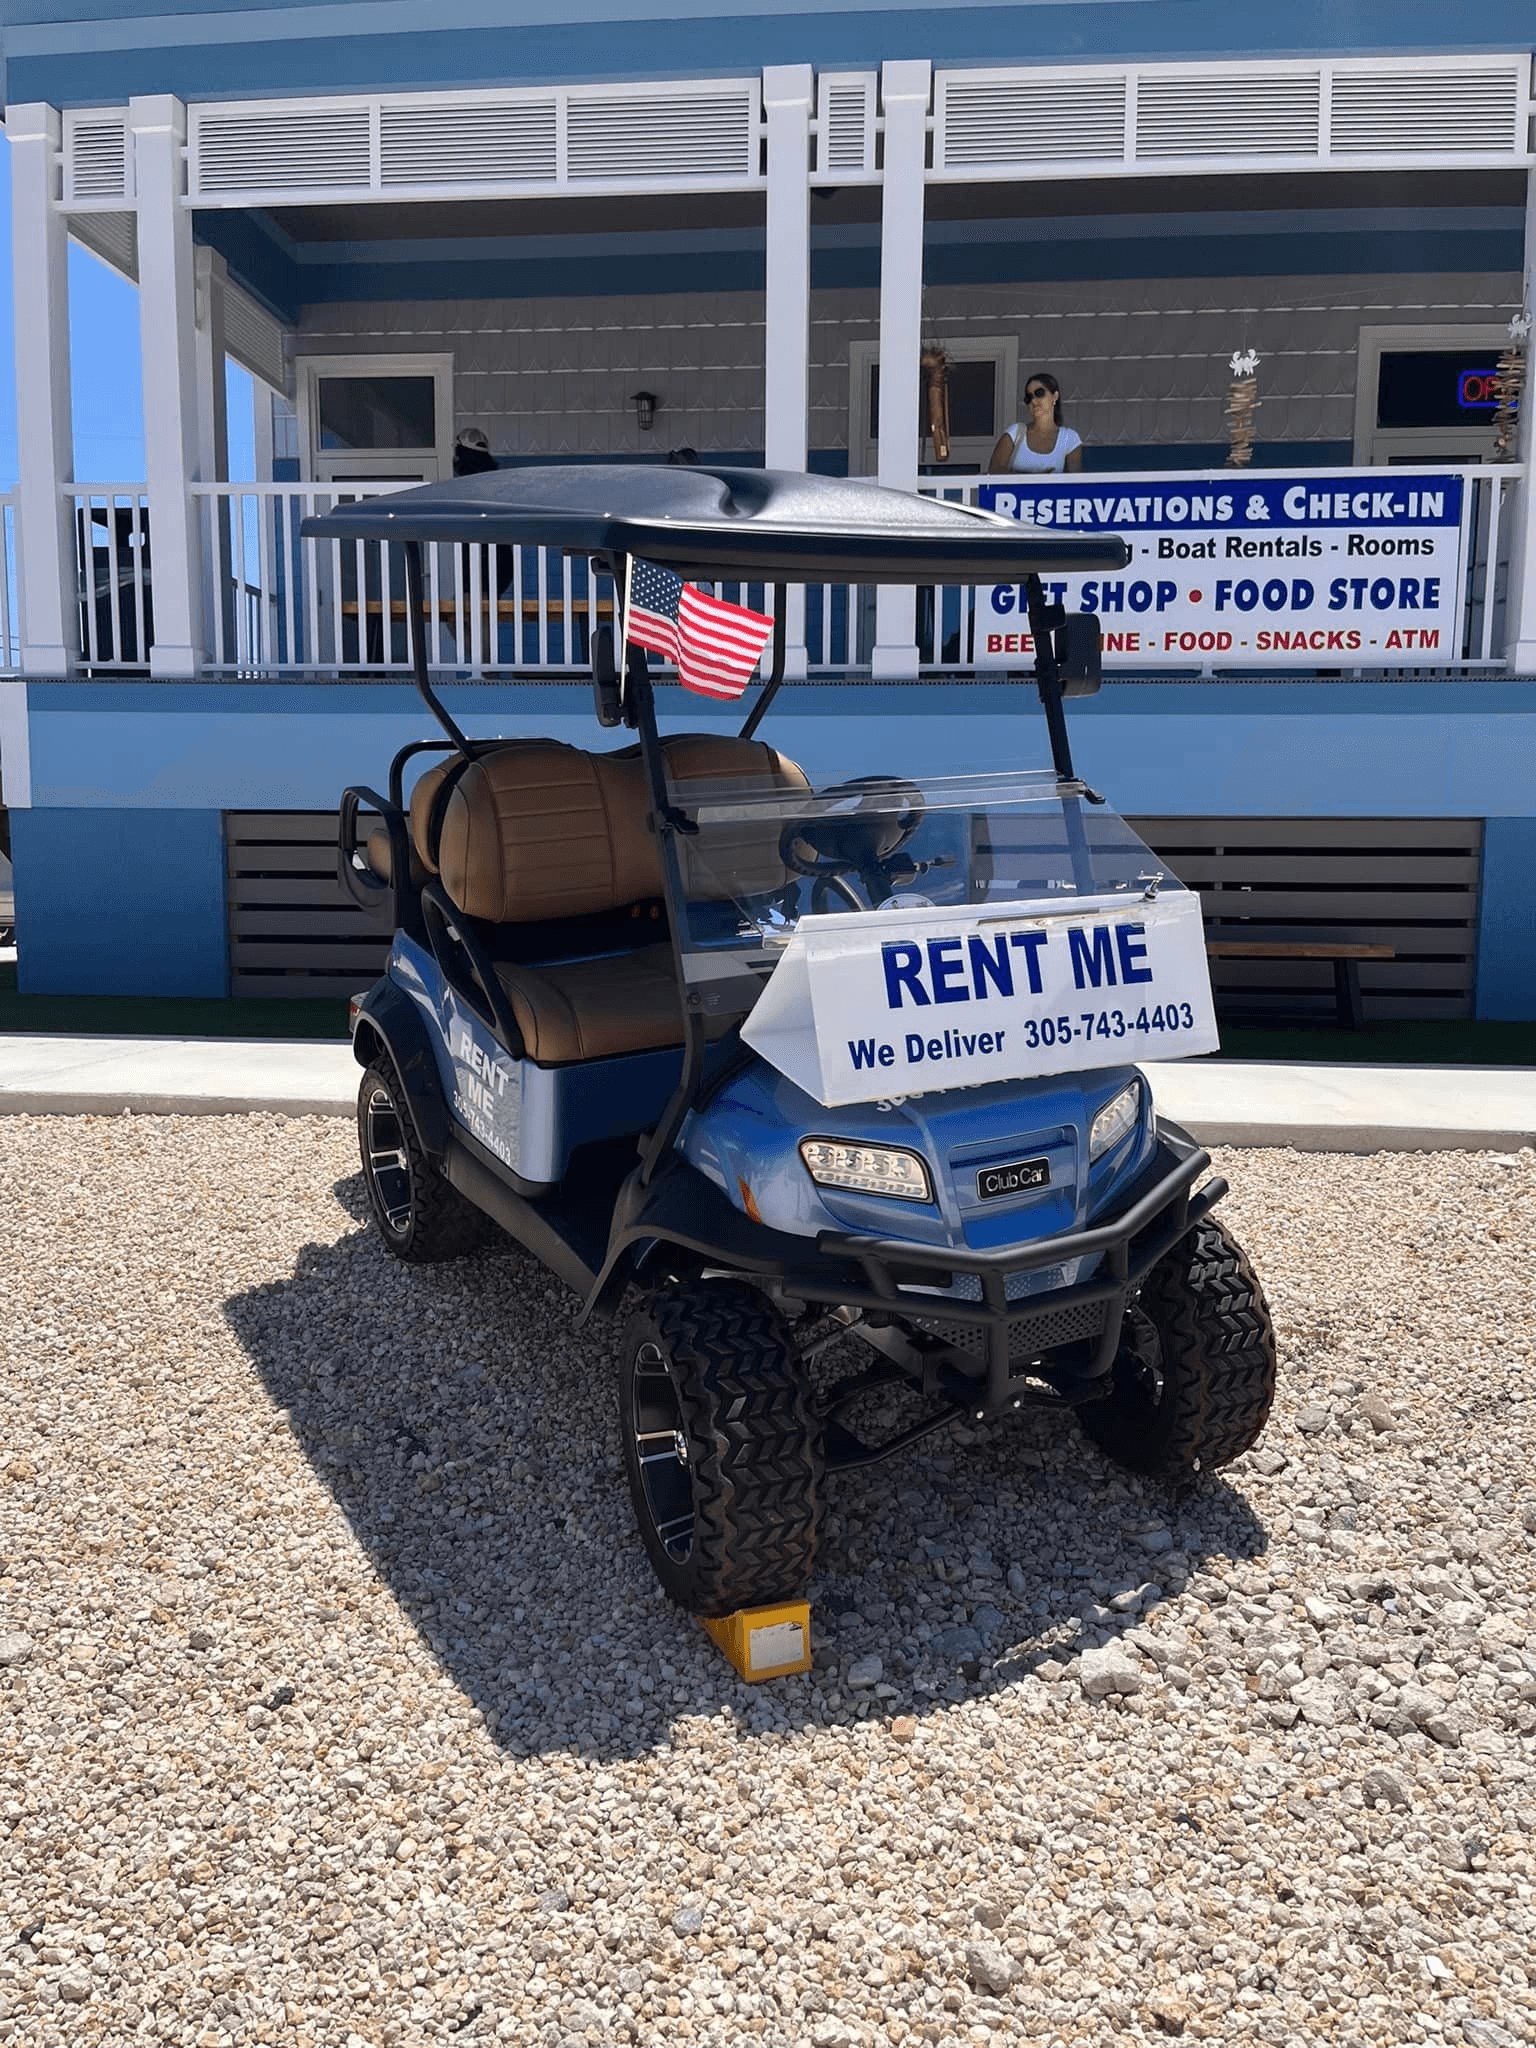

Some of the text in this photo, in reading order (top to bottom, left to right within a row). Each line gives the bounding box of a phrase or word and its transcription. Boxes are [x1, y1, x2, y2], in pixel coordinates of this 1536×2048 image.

[1464, 376, 1499, 401] OP
[995, 486, 1444, 525] RESERVATIONS & CHECK-IN
[1158, 537, 1217, 559] Boat
[1225, 535, 1323, 558] Rentals
[1347, 534, 1434, 556] Rooms
[1080, 580, 1177, 612] SHOP
[1215, 578, 1314, 612] FOOD
[1328, 577, 1440, 611] STORE
[987, 634, 1034, 652] BEE
[1164, 631, 1232, 651] FOOD
[1256, 630, 1361, 650] SNACKS
[1384, 629, 1439, 649] ATM
[881, 922, 1153, 1009] RENT ME
[848, 1002, 1195, 1070] We Deliver 305-743-4403
[460, 1032, 509, 1097] RENT
[468, 1074, 494, 1120] ME
[986, 1167, 1044, 1192] Club Car
